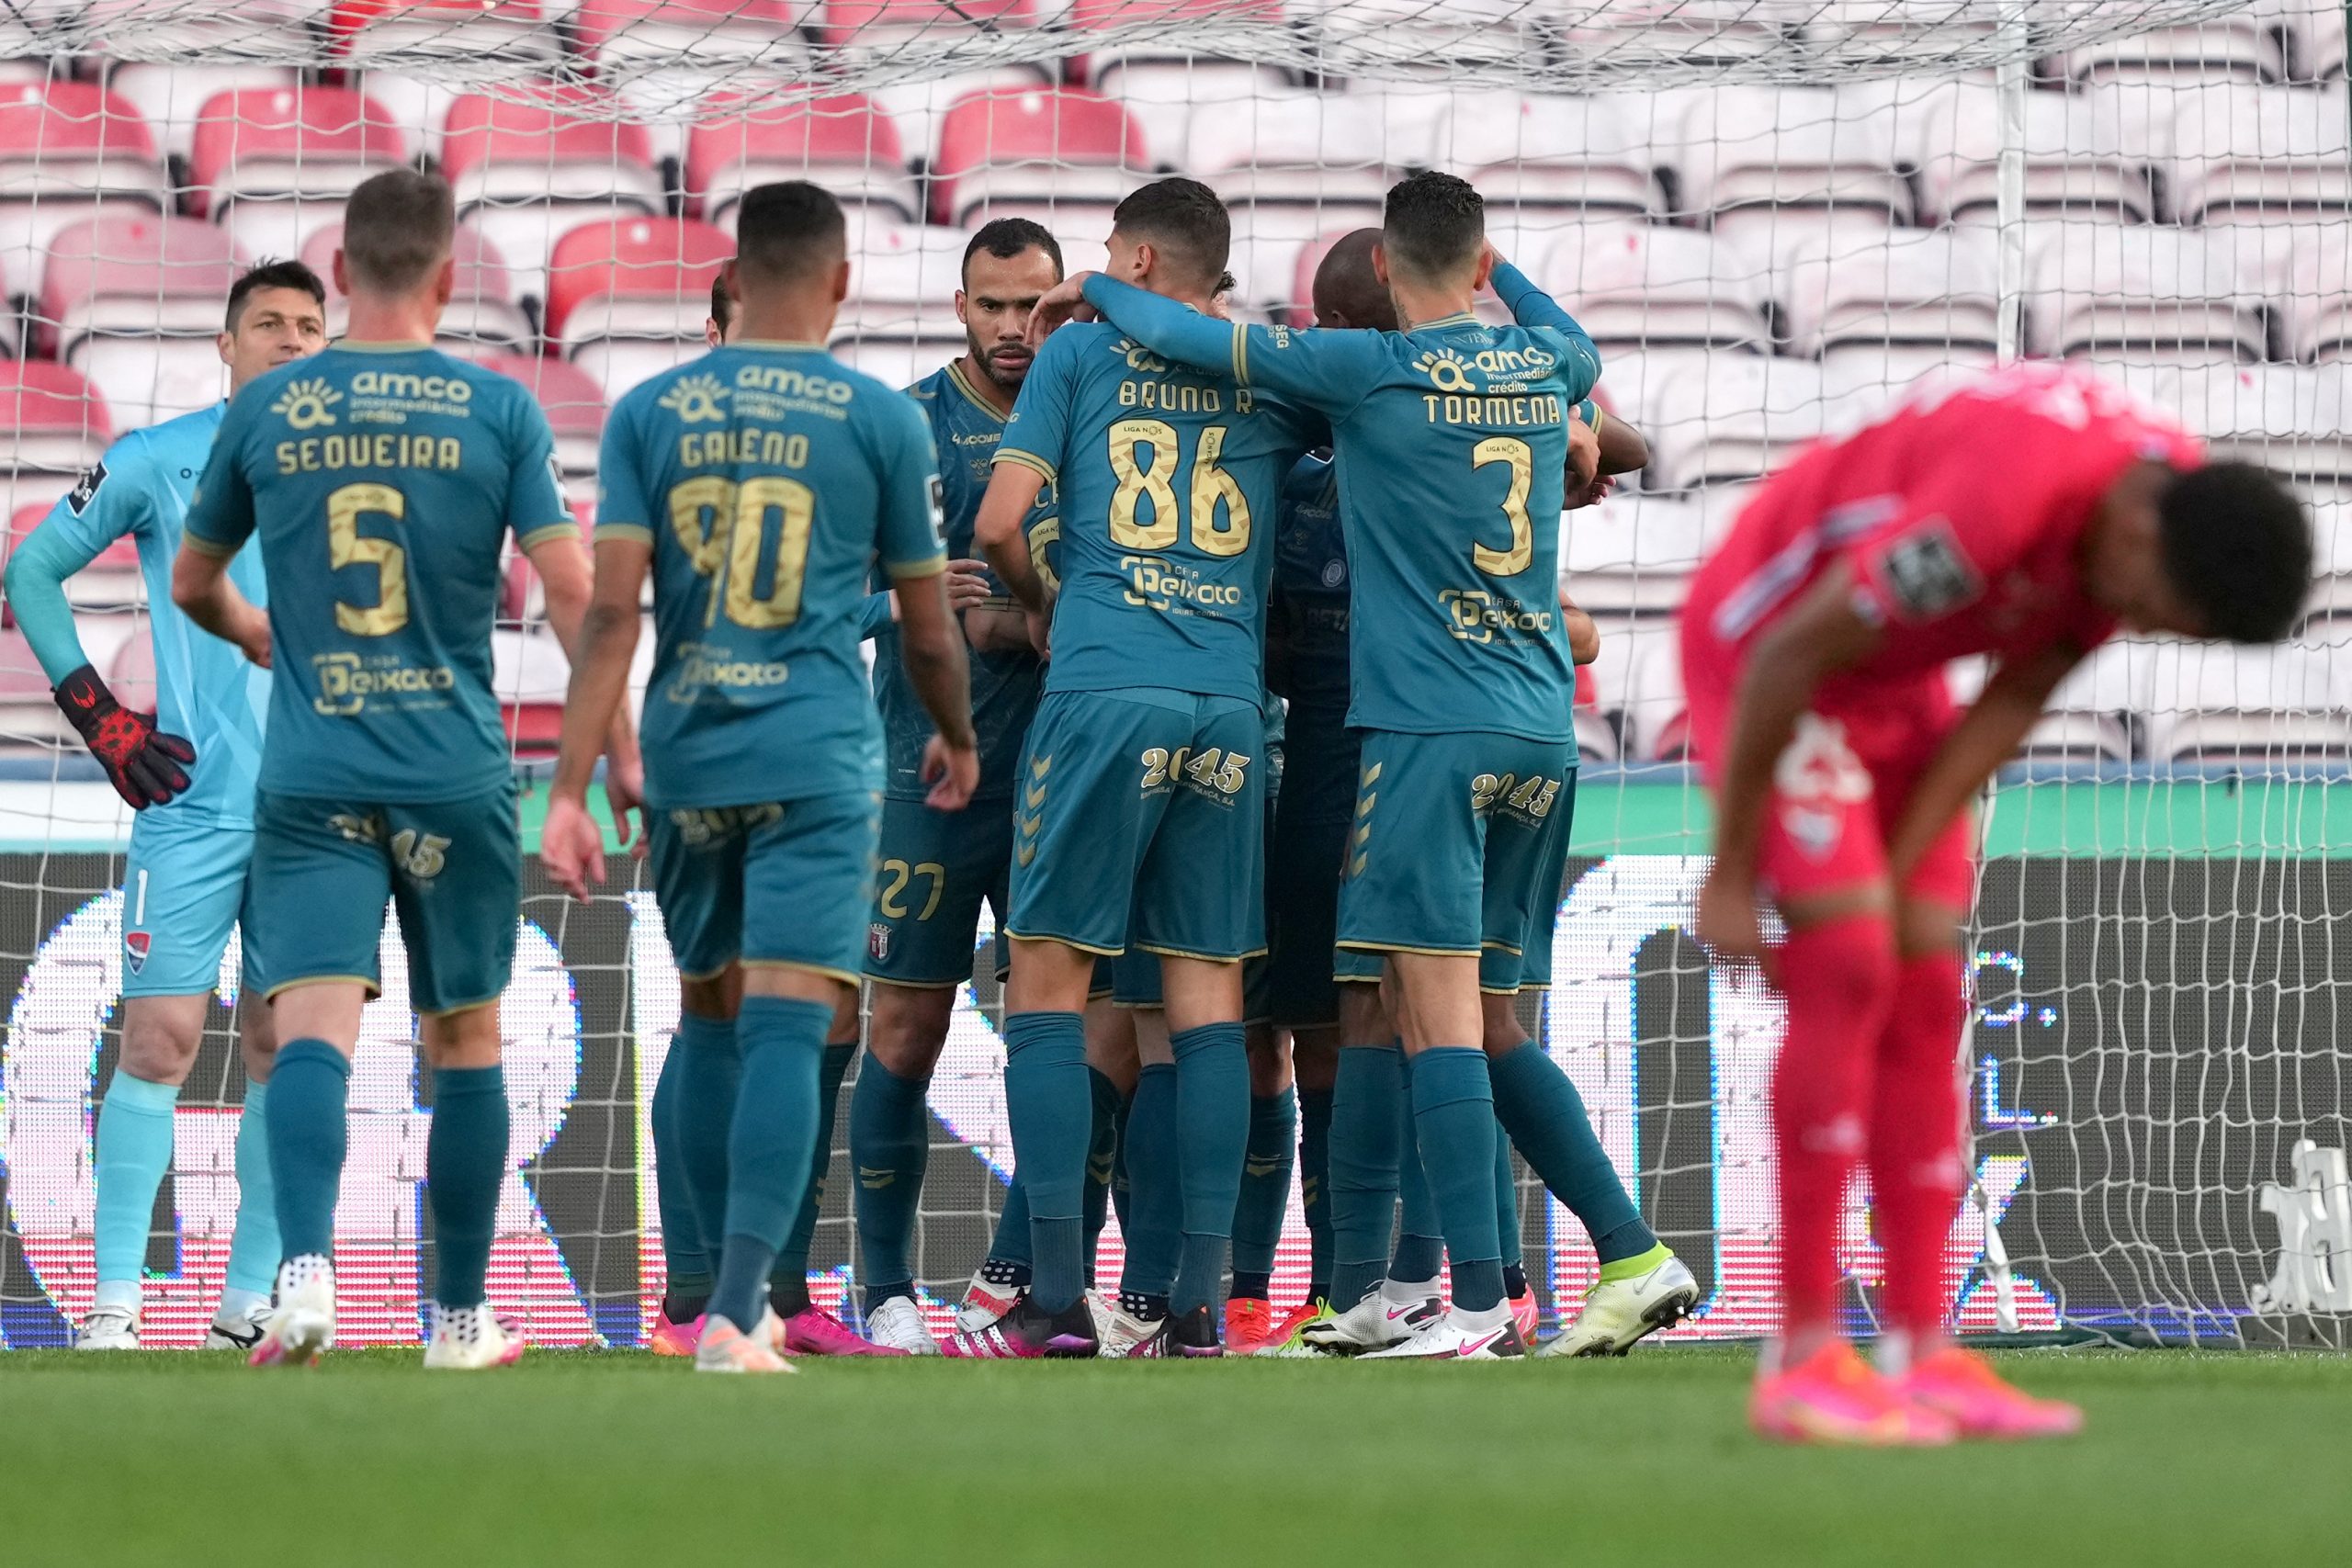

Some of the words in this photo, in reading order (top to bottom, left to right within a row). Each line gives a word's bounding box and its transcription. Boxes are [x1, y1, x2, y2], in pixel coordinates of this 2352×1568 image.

[350, 371, 472, 403] amco
[736, 366, 853, 404] amco
[1118, 379, 1221, 412] BRUNO
[1487, 380, 1529, 394] crédito
[1422, 395, 1561, 426] TORMENA
[276, 433, 460, 475] SEQUEIRA
[680, 427, 809, 469] GALENO
[1108, 419, 1252, 557] 86
[1473, 435, 1533, 578] 3
[327, 481, 409, 637] 5
[668, 474, 816, 630] 90
[134, 868, 149, 927] 1
[880, 858, 944, 921] 27
